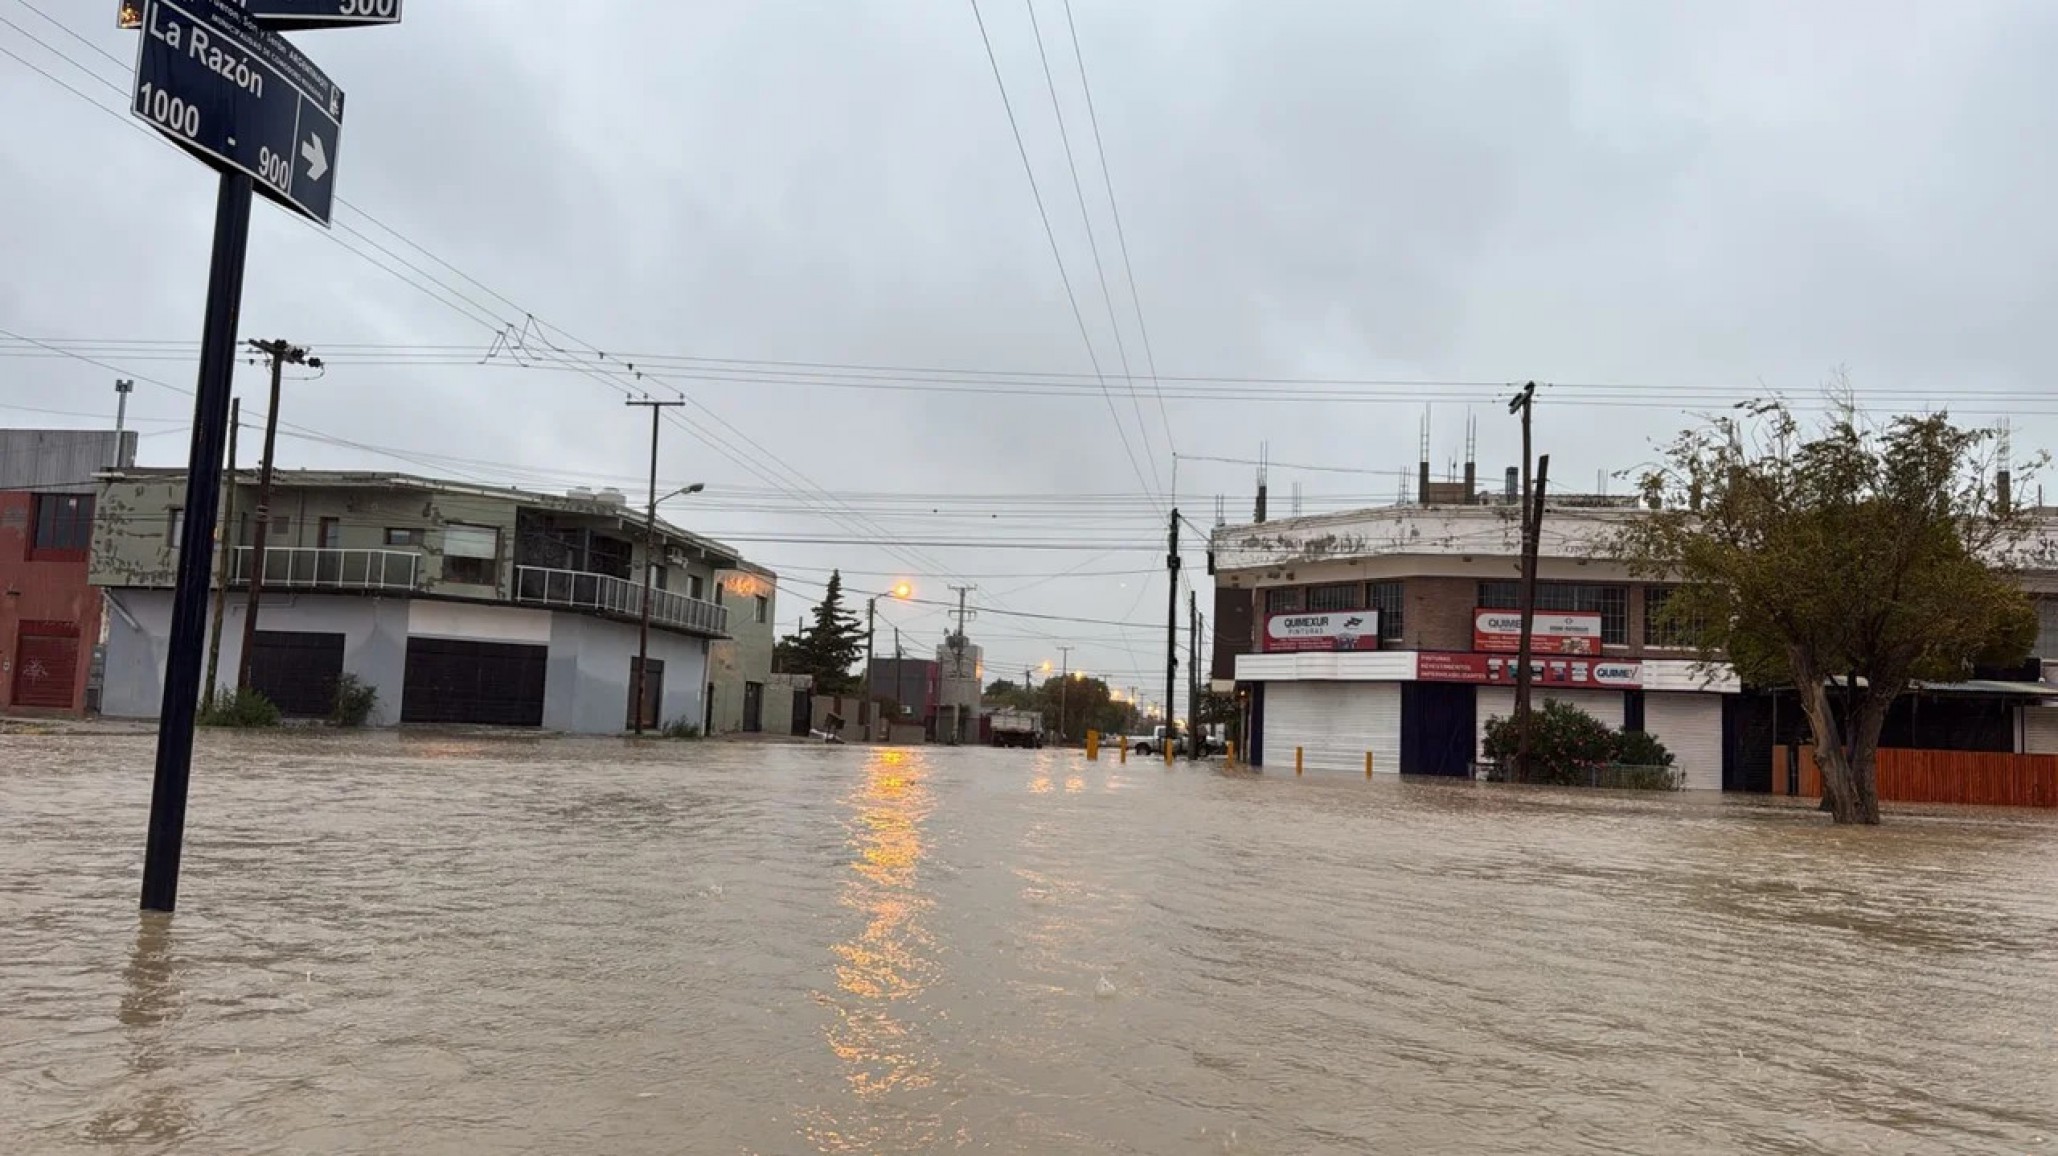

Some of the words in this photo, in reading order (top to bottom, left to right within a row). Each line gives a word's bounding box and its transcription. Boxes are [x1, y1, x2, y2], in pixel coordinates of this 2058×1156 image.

[150, 2, 181, 50] La
[189, 25, 263, 98] Razón
[139, 82, 200, 138] 1000
[258, 146, 289, 190] 900
[1284, 616, 1329, 628] QUIMEXUR
